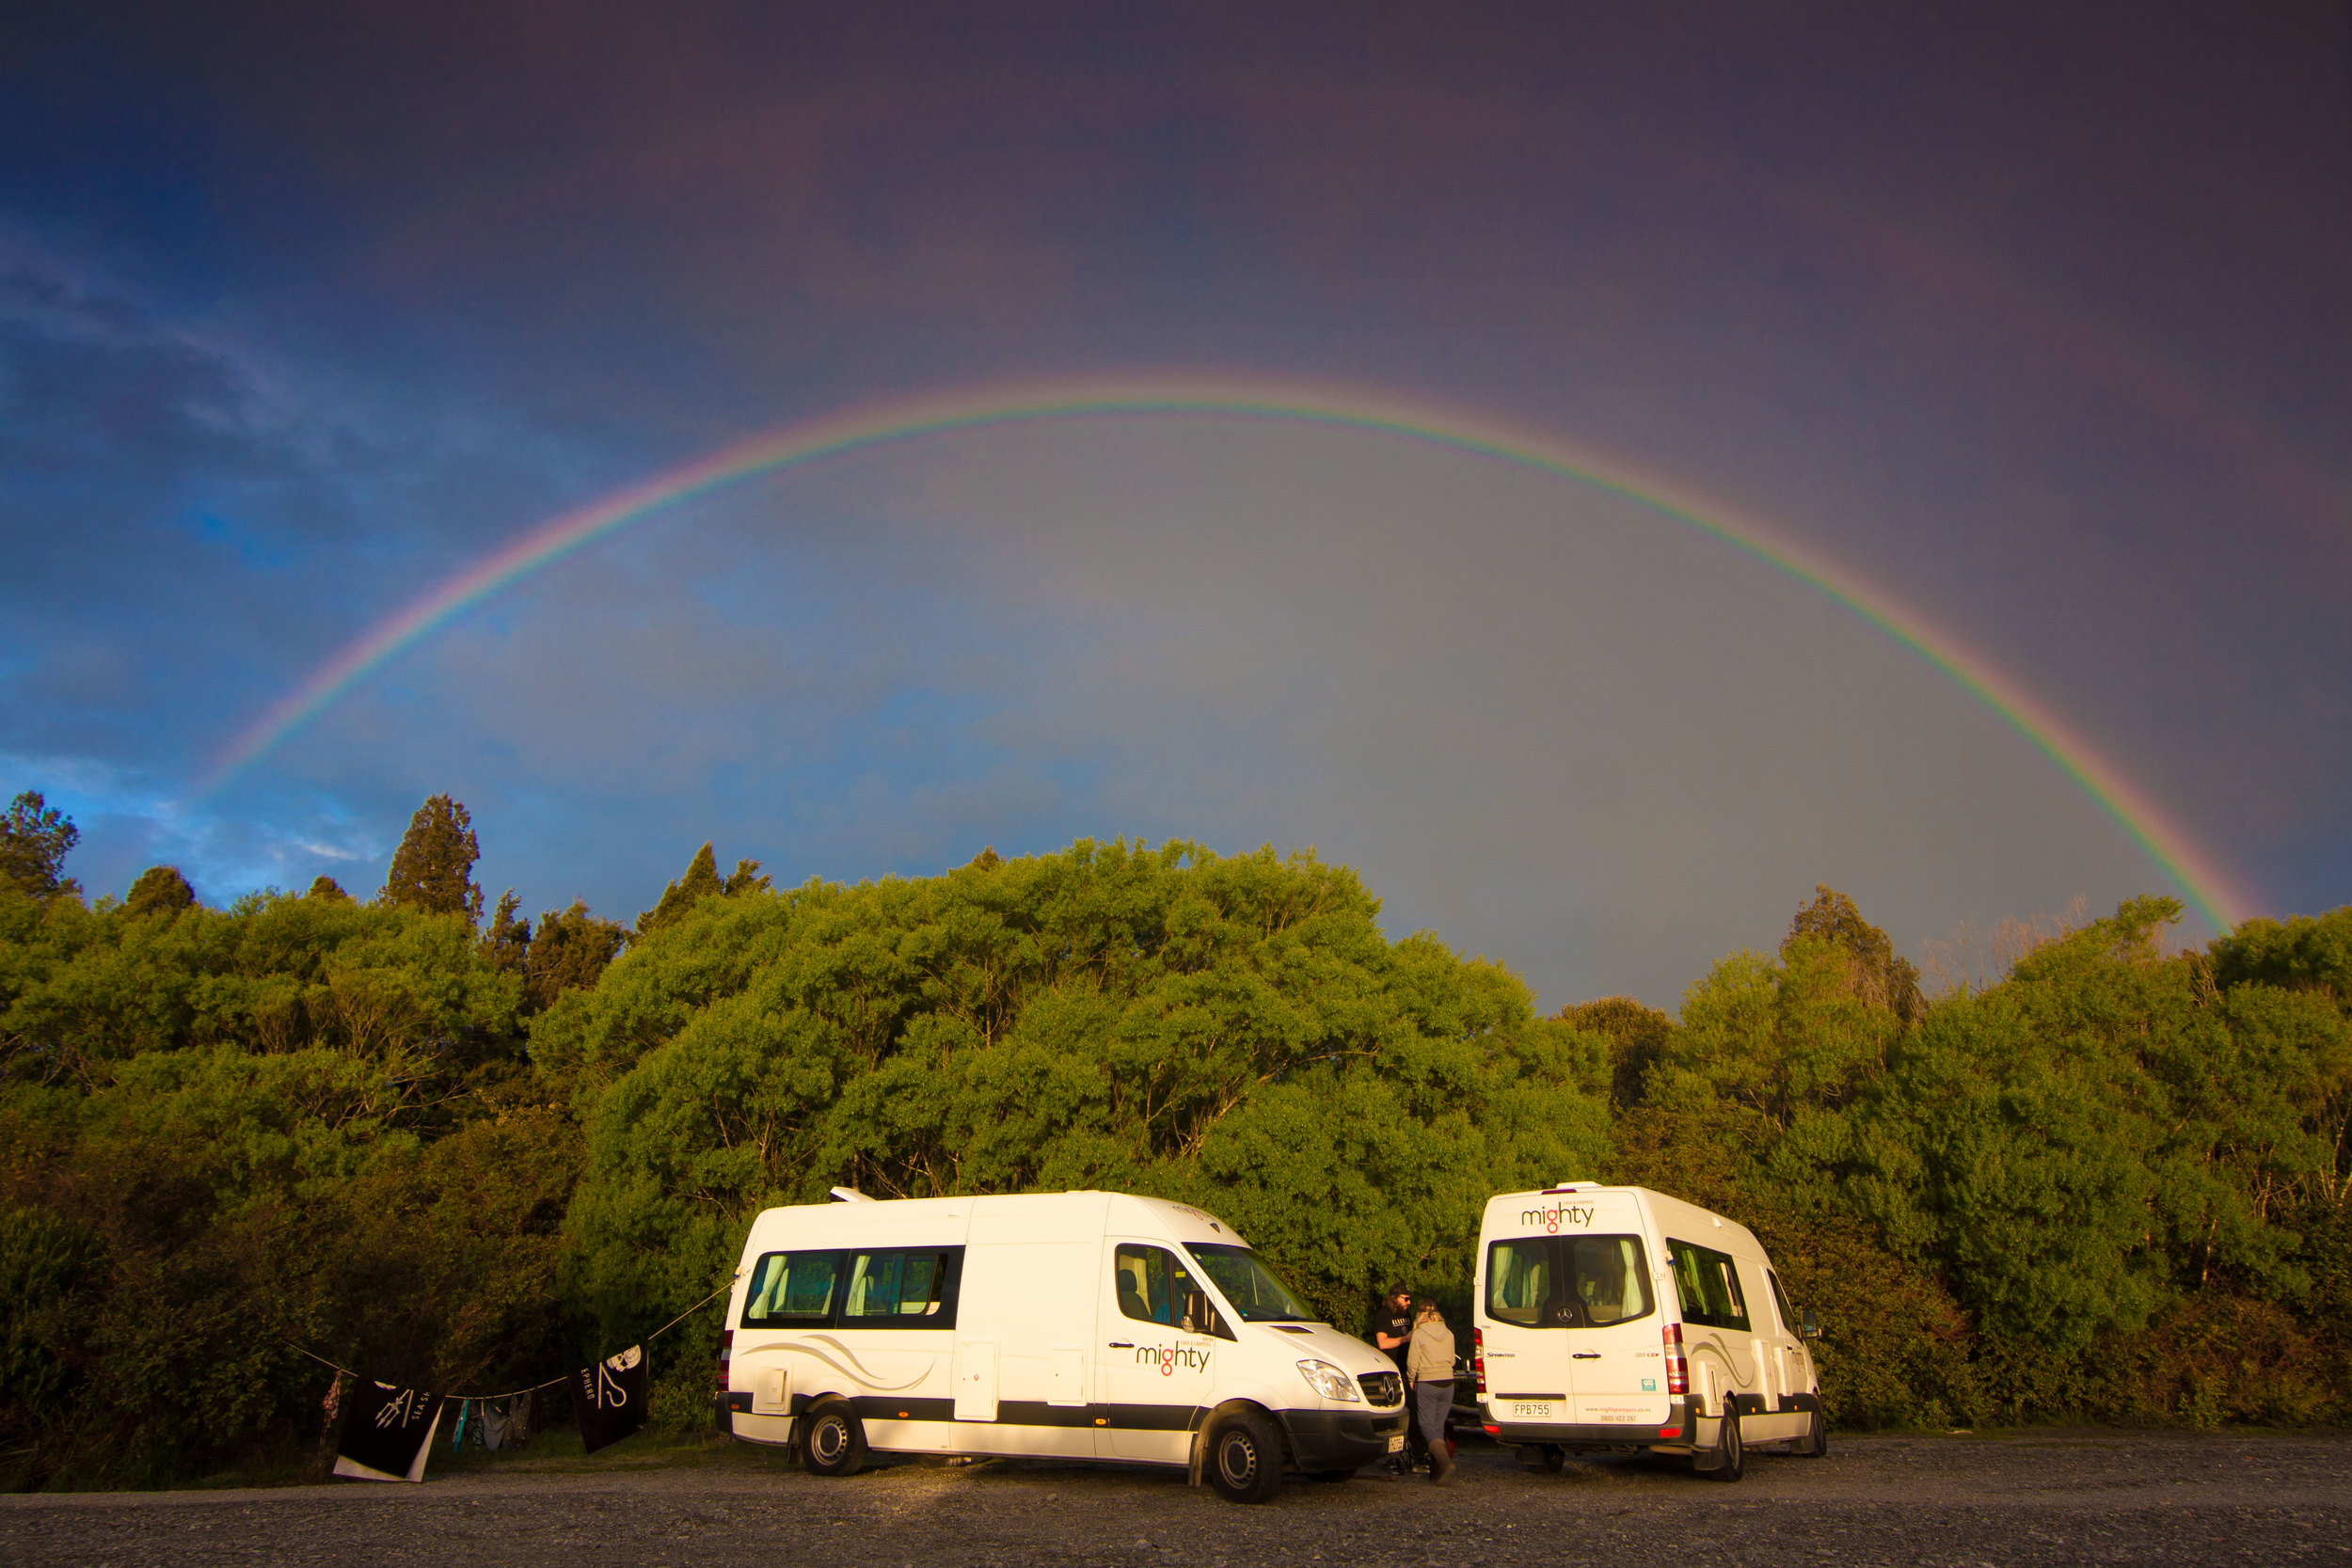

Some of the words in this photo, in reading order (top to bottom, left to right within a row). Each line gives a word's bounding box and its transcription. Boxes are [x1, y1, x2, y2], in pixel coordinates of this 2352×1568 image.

[1521, 1201, 1594, 1234] mighty
[1136, 1340, 1210, 1376] mighty
[1514, 1404, 1549, 1415] FPB755
